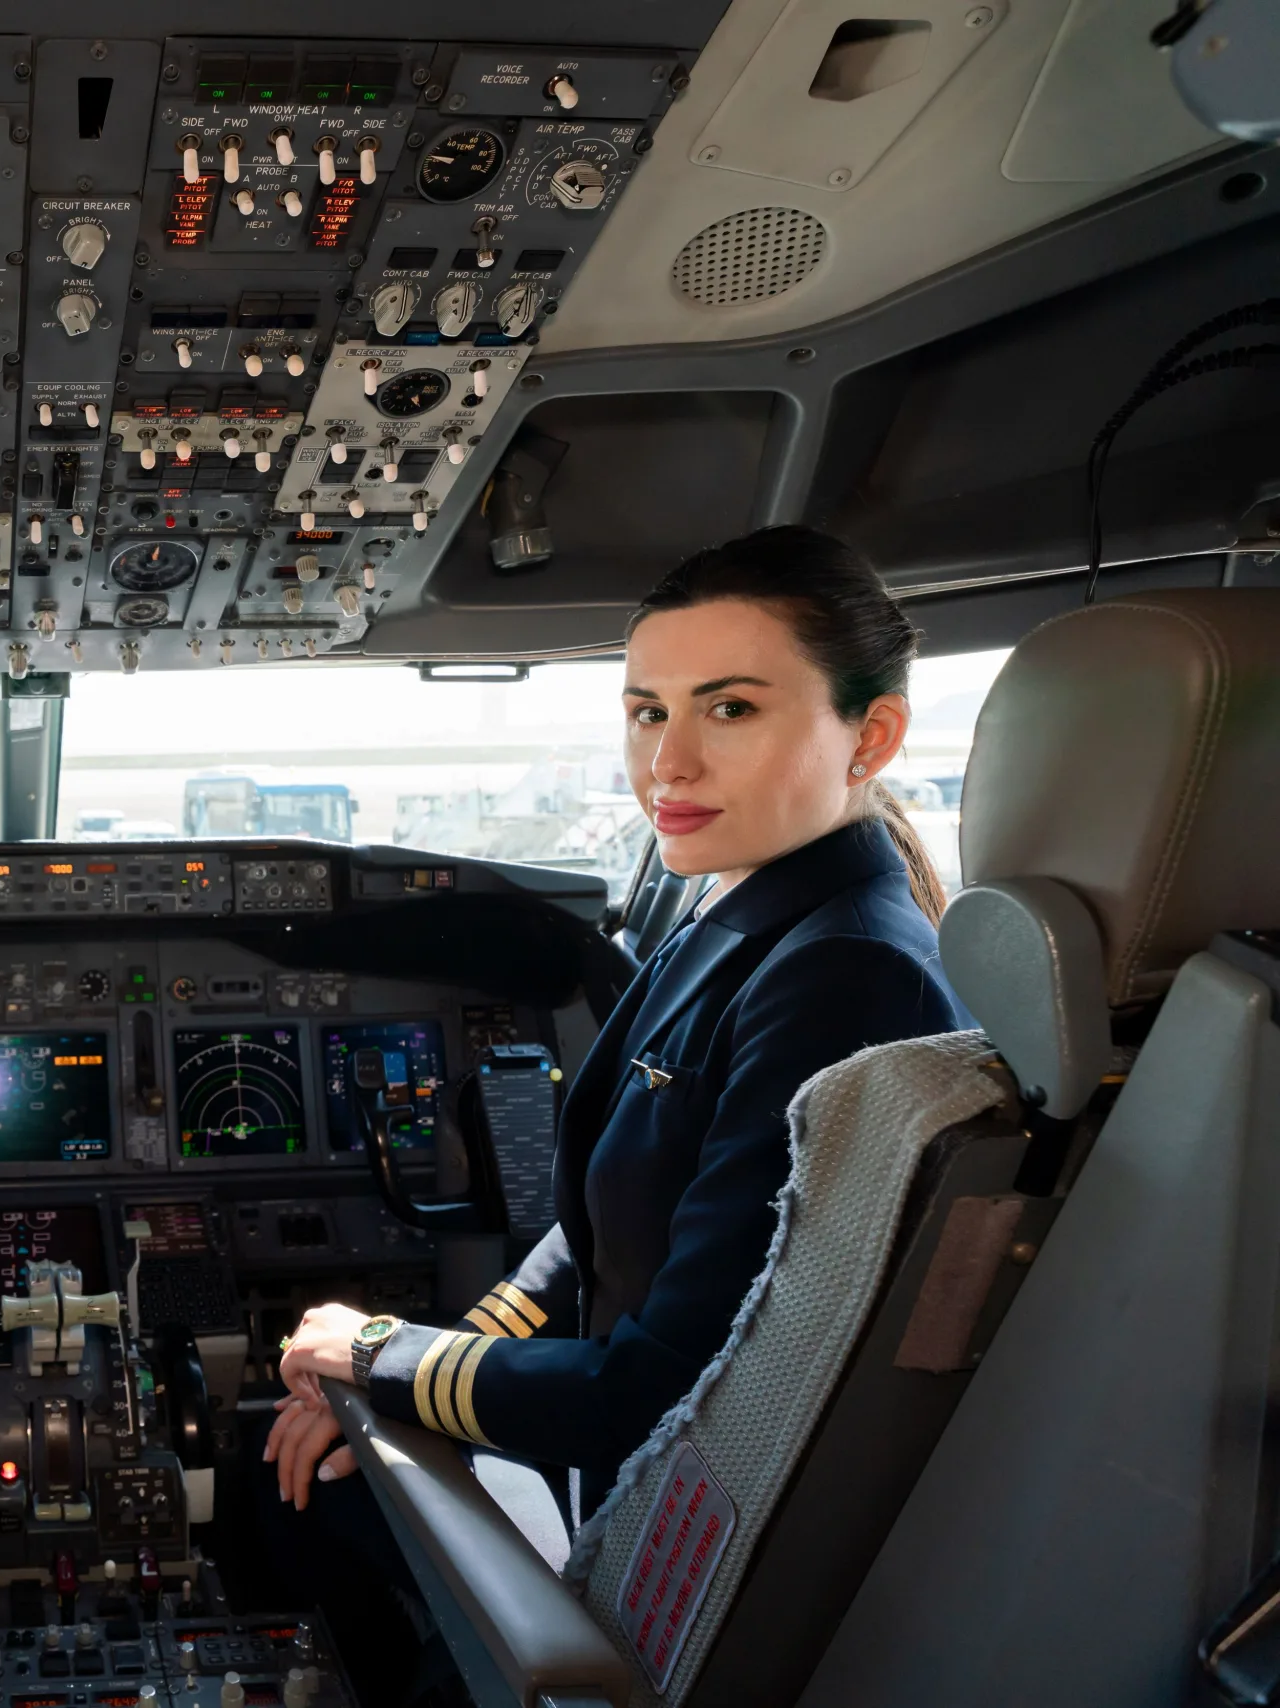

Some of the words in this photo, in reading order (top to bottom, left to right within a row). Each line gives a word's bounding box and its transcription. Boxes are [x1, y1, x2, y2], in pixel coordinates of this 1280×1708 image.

[496, 65, 523, 73] VOICE
[557, 62, 579, 70] AUTO
[480, 75, 530, 85] RECORDER
[261, 91, 272, 99] ON
[364, 92, 375, 100] ON
[249, 105, 294, 114] WINDOW
[297, 105, 327, 114] HEAT
[274, 114, 297, 122] OVHT
[181, 118, 204, 127] SIDE
[223, 119, 249, 127] FWD
[320, 119, 344, 128] FWD
[362, 120, 387, 129] SIDE
[204, 128, 221, 136] OFF
[536, 125, 554, 134] AIR
[557, 125, 585, 134] TEMP
[611, 128, 635, 136] PASS
[613, 136, 632, 144] CAB
[577, 145, 597, 153] FWD
[554, 152, 572, 160] AFT
[595, 153, 615, 161] AFT
[256, 167, 289, 175] PROBE
[256, 183, 280, 191] AUTO
[42, 201, 80, 211] CIRCUIT
[82, 201, 131, 211] BREAKER
[473, 204, 495, 212] TRIM
[497, 204, 514, 212] AIR
[68, 215, 103, 226] BRIGHT
[245, 221, 272, 229] HEAT
[382, 270, 411, 278] CONT
[413, 270, 430, 278] CAB
[446, 271, 470, 279] FWD
[471, 271, 491, 279] CAB
[510, 272, 531, 280] AFT
[533, 272, 552, 280] CAB
[63, 279, 95, 287] PANEL
[296, 530, 333, 540] 34000
[113, 1401, 124, 1412] 30
[116, 1428, 128, 1438] 40
[652, 1511, 669, 1550] MUST
[665, 1492, 677, 1516] BE
[673, 1475, 684, 1496] IN
[666, 1515, 692, 1574] POSITION
[687, 1477, 708, 1518] WHEN
[688, 1513, 720, 1581] OUTBOARD
[668, 1577, 693, 1628] MOVING
[664, 1624, 673, 1644] IS
